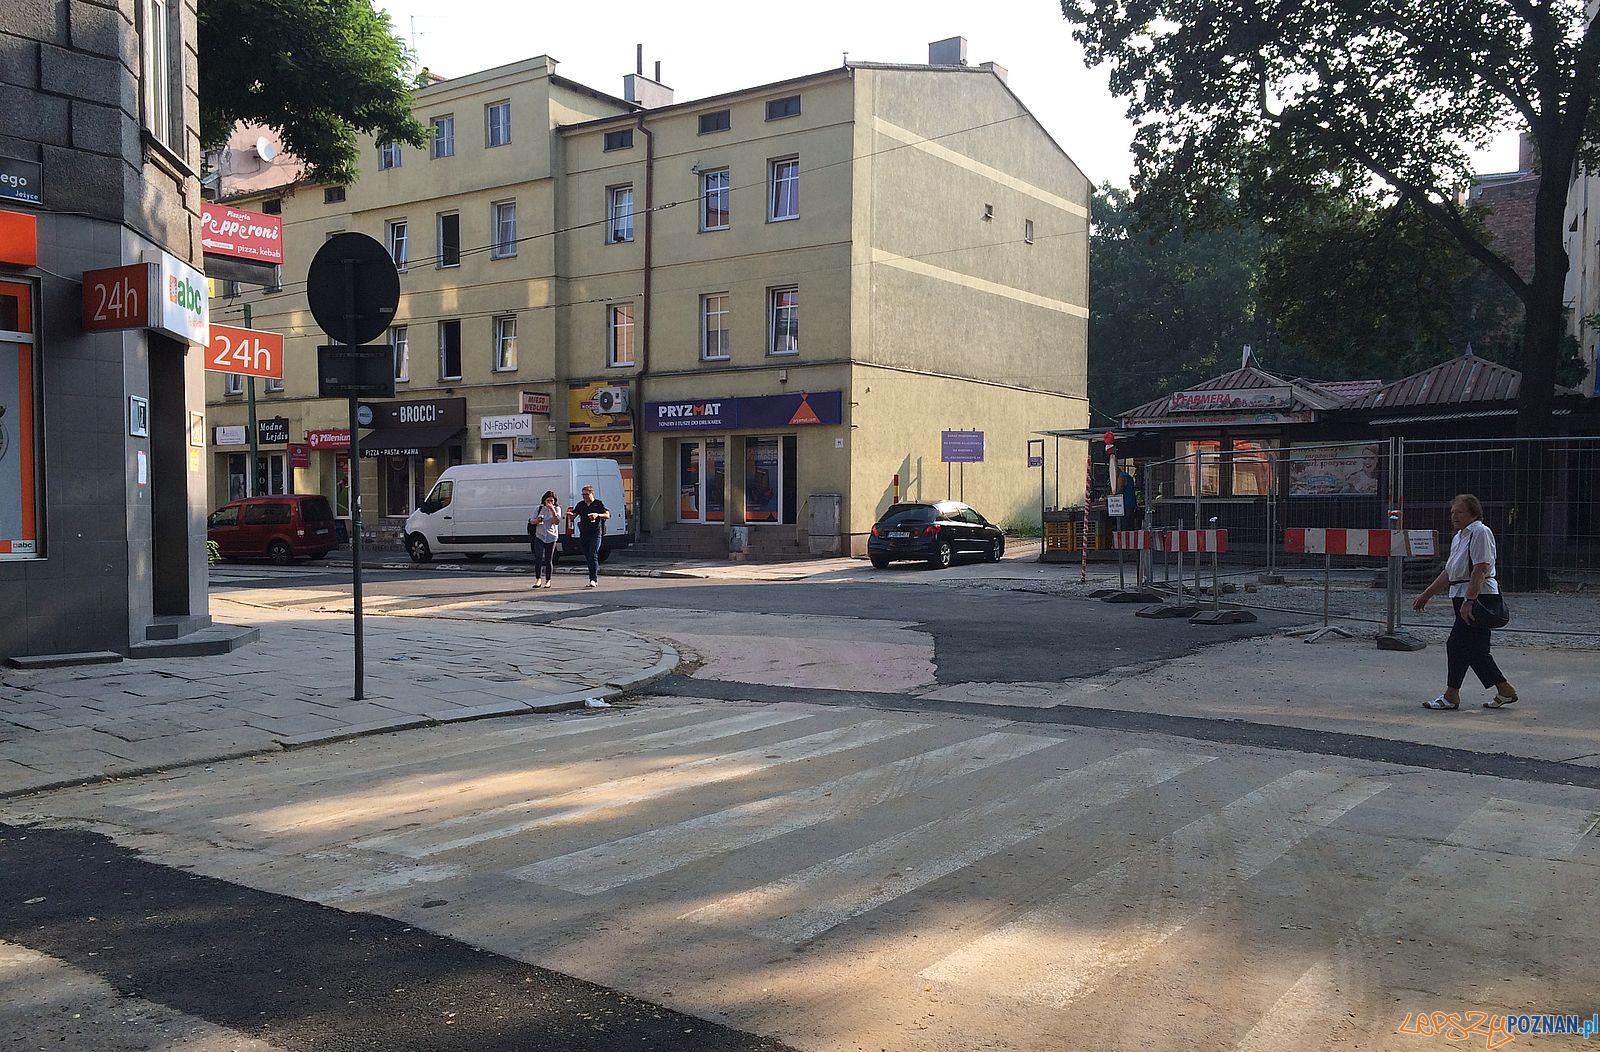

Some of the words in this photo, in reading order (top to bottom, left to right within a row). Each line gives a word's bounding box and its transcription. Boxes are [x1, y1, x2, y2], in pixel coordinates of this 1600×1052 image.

[200, 212, 278, 240] Pepperoni
[237, 245, 259, 255] pizza,
[259, 247, 281, 258] kebab
[93, 276, 138, 321] 24h
[177, 277, 202, 315] abc
[213, 335, 272, 371] 24h
[400, 405, 436, 423] BROCCI
[658, 403, 721, 418] PRYZMAT
[260, 423, 283, 431] Modne
[265, 432, 288, 442] Lejdis
